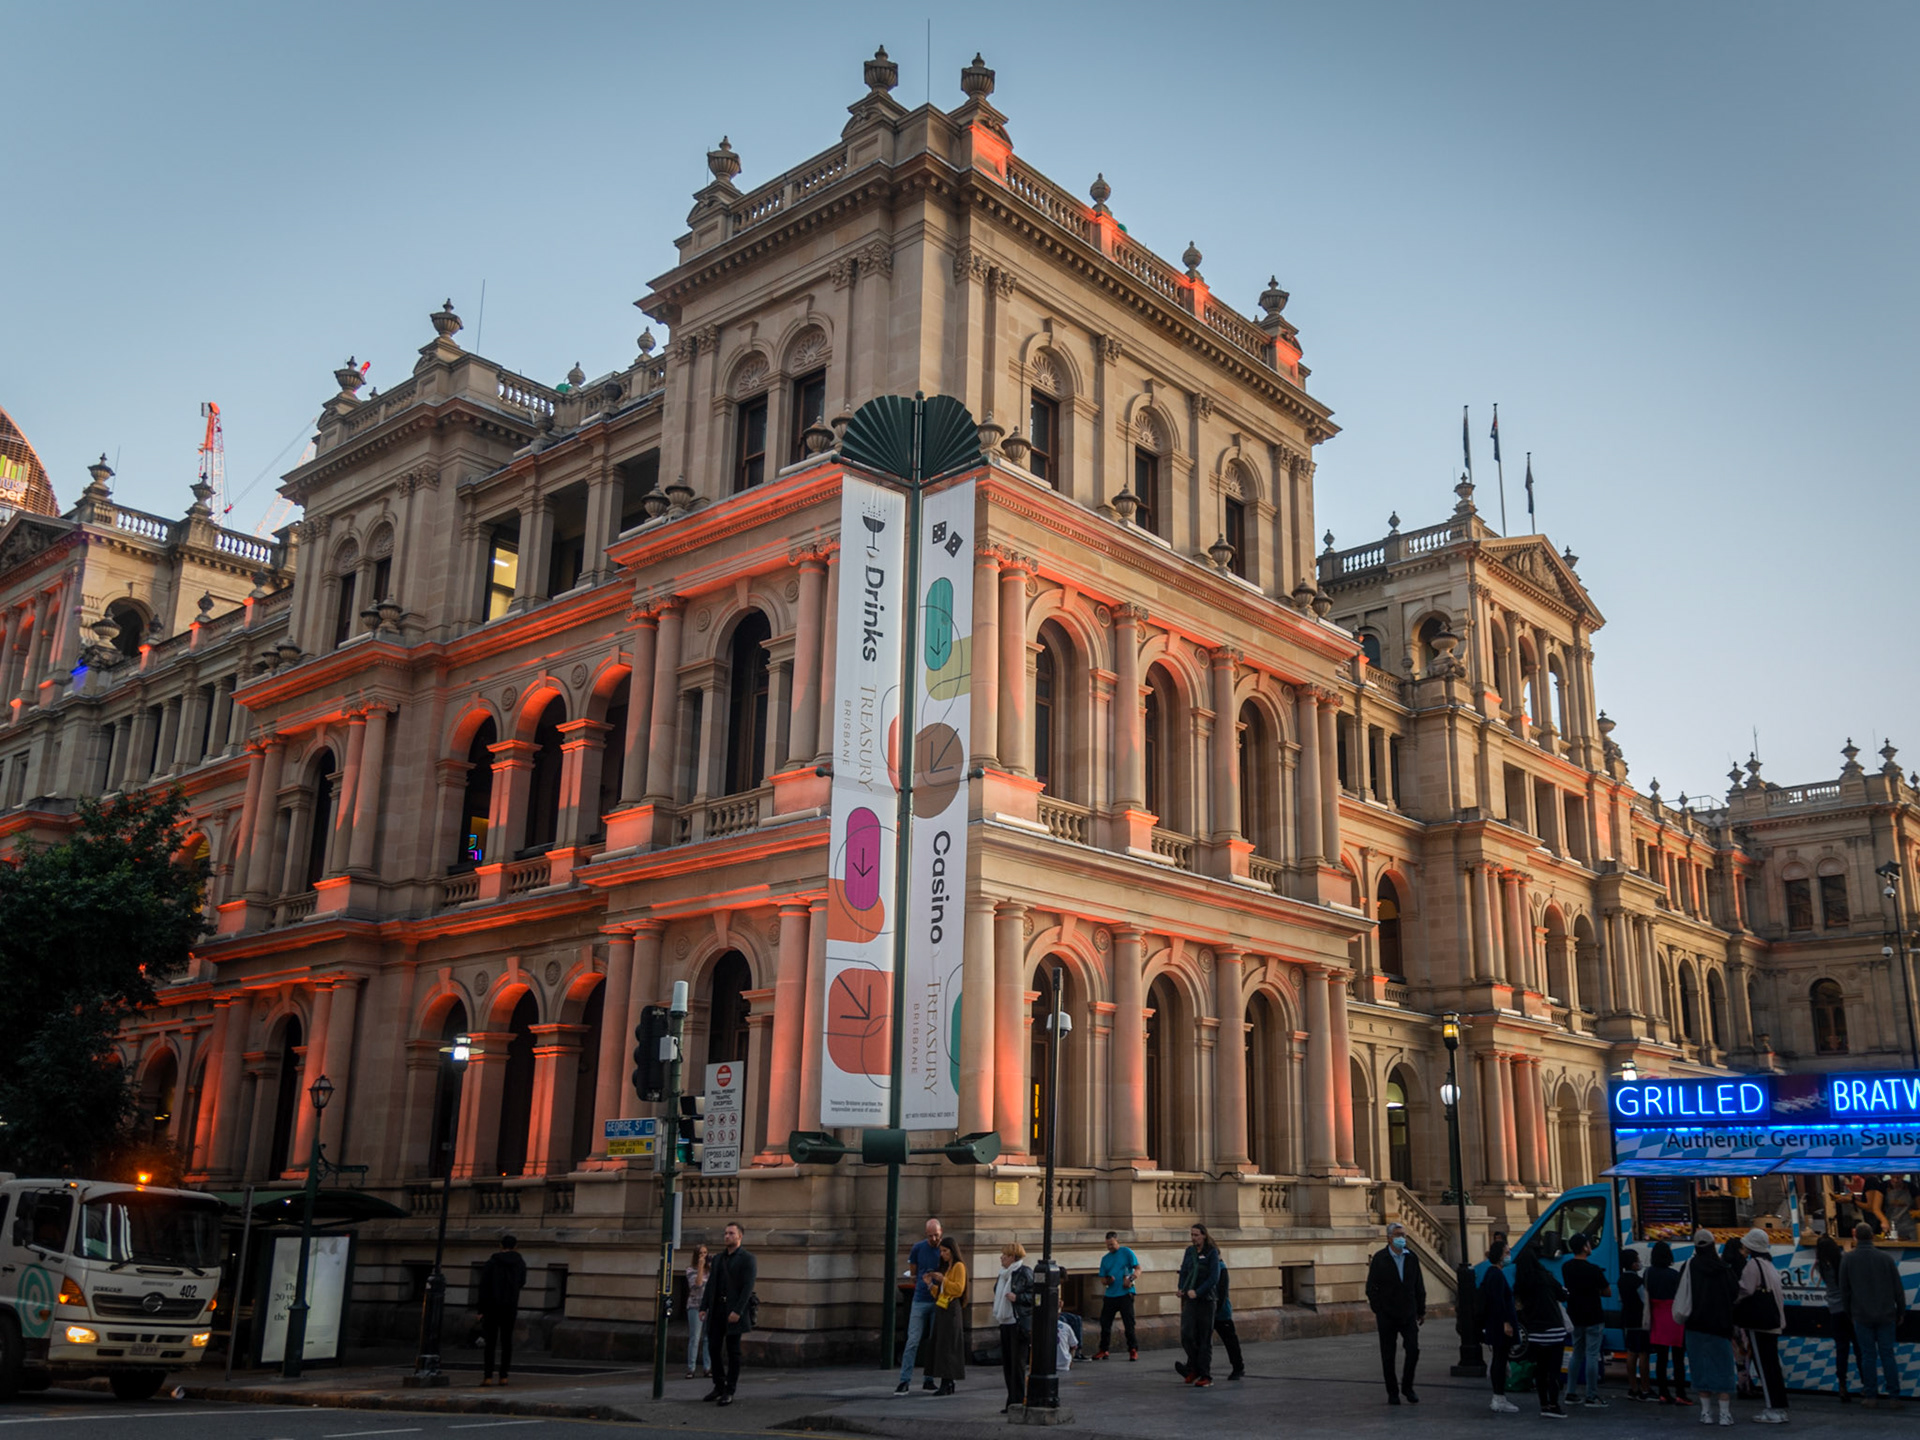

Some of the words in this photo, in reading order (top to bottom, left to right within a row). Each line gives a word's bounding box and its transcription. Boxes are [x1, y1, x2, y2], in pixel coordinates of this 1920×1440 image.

[862, 565, 885, 663] Drinks
[842, 699, 852, 766] BRISBANE
[858, 684, 877, 792] TREASURY
[930, 830, 951, 945] Casino
[911, 1002, 920, 1074] BRISBANE
[923, 976, 942, 1096] TREASURY
[607, 1121, 632, 1132] GEORGE
[1615, 1083, 1764, 1116] GRILLED
[1667, 1131, 1765, 1148] Authentic
[1770, 1130, 1854, 1147] German
[180, 1284, 197, 1298] 402
